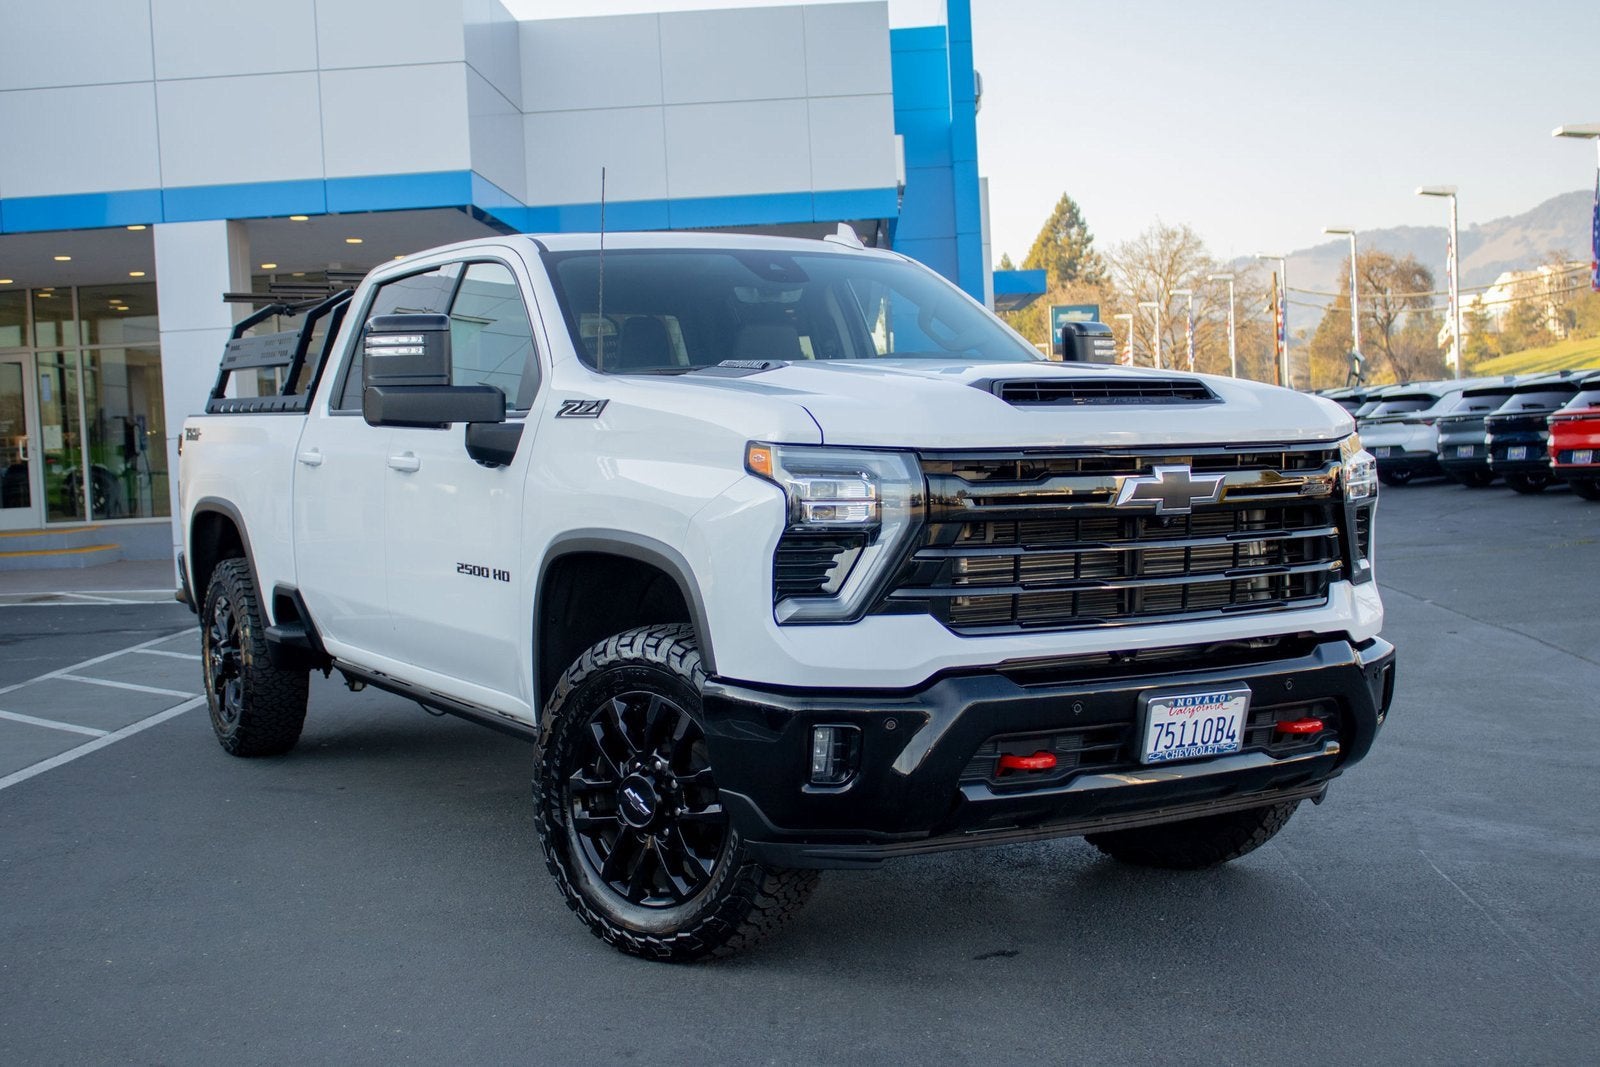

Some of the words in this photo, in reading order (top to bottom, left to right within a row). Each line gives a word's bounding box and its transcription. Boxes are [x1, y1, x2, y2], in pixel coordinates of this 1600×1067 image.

[456, 562, 489, 578] 2500
[493, 568, 510, 582] HD
[1176, 694, 1226, 707] NOVATO
[1168, 703, 1229, 718] California
[1153, 715, 1236, 752] 75110B4
[1165, 745, 1220, 760] CHEVROLET
